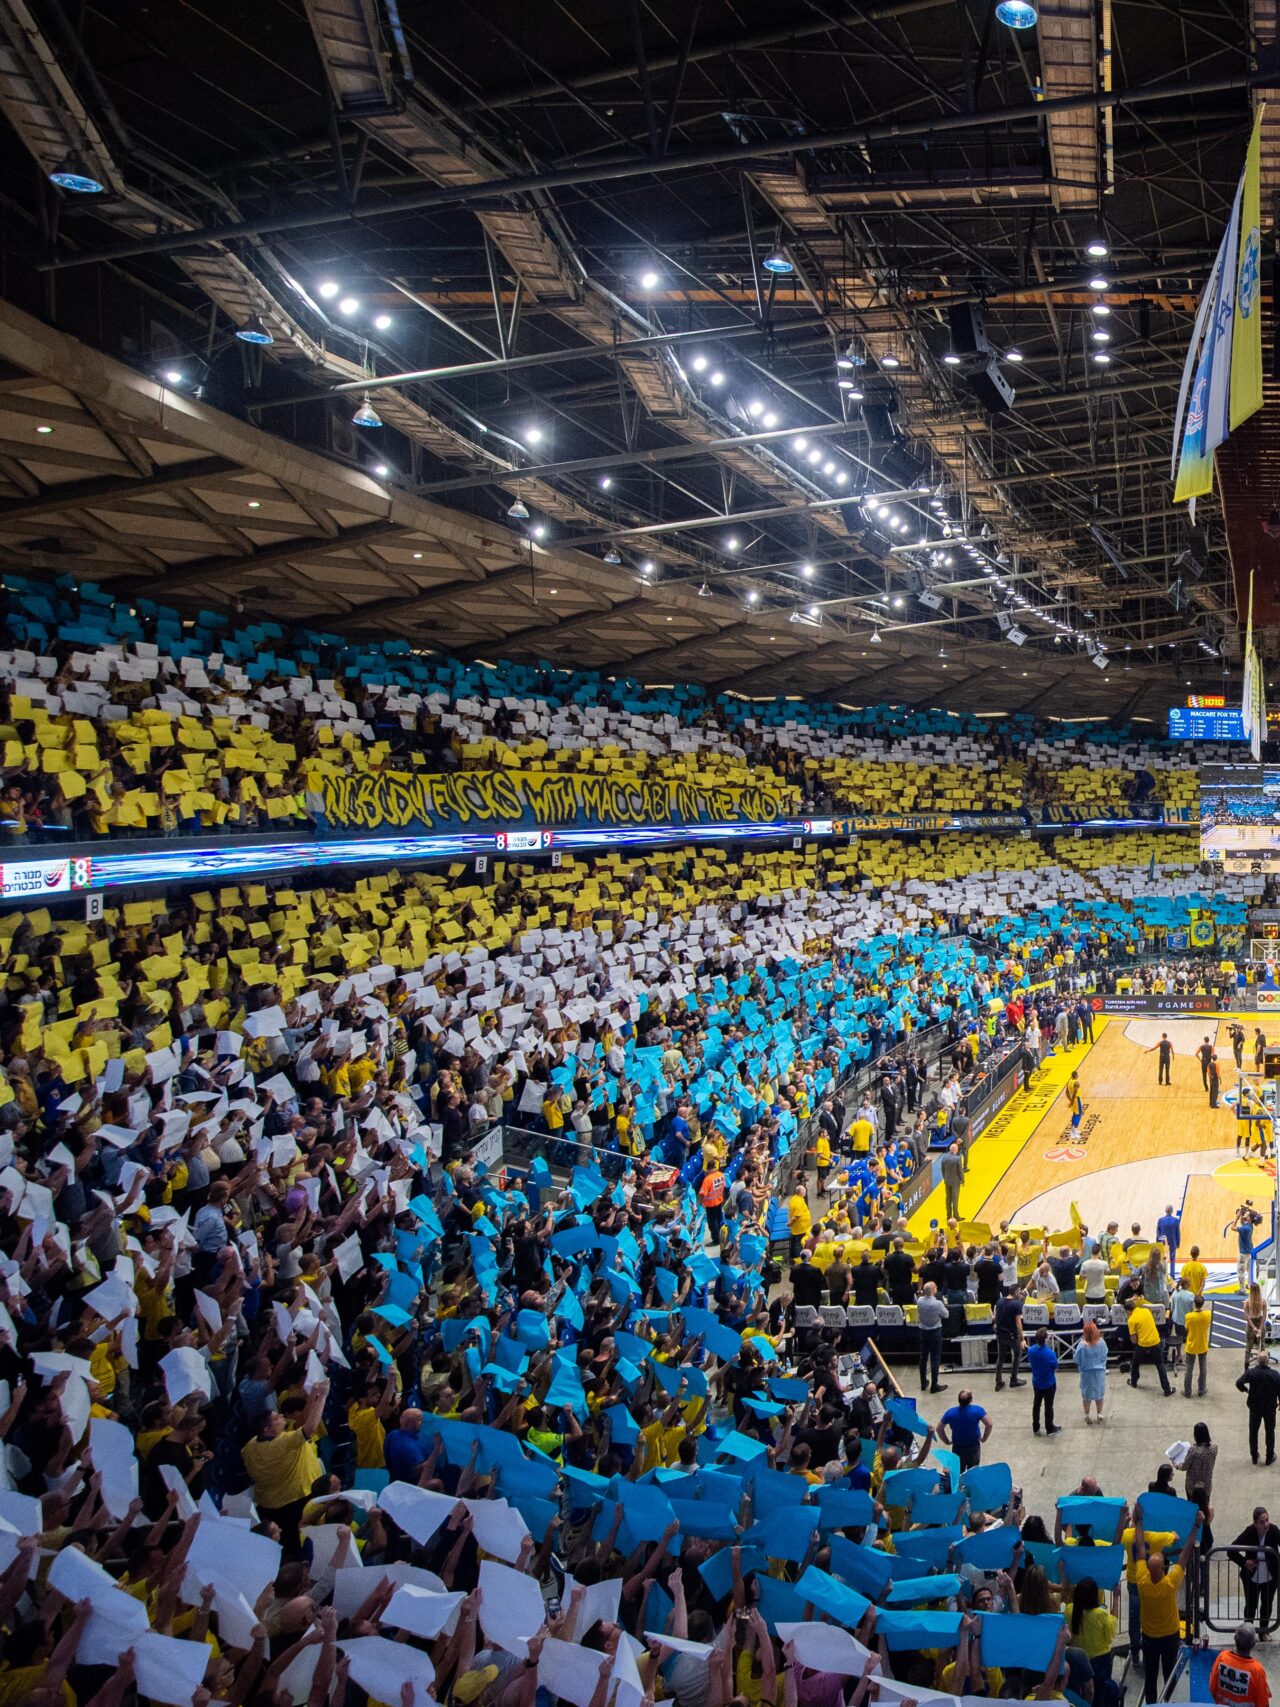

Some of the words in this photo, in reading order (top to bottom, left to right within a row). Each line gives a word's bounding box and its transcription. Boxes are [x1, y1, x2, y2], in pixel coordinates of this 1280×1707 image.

[322, 772, 433, 830] NOBODY
[429, 771, 524, 824] FUCKS
[521, 775, 576, 824] WITH
[581, 778, 672, 823] MACCABI
[677, 783, 700, 822] IN
[699, 787, 739, 821] THE
[1048, 805, 1113, 822] ULTRAS
[804, 822, 810, 834] 9
[496, 834, 505, 850] 8
[543, 832, 551, 847] 9
[479, 859, 484, 869] 8
[554, 854, 560, 863] 9
[14, 870, 42, 880] מנורה
[74, 860, 88, 886] 8
[3, 881, 42, 892] מבטחים
[91, 899, 99, 915] 8
[983, 1113, 1017, 1138] MENORA
